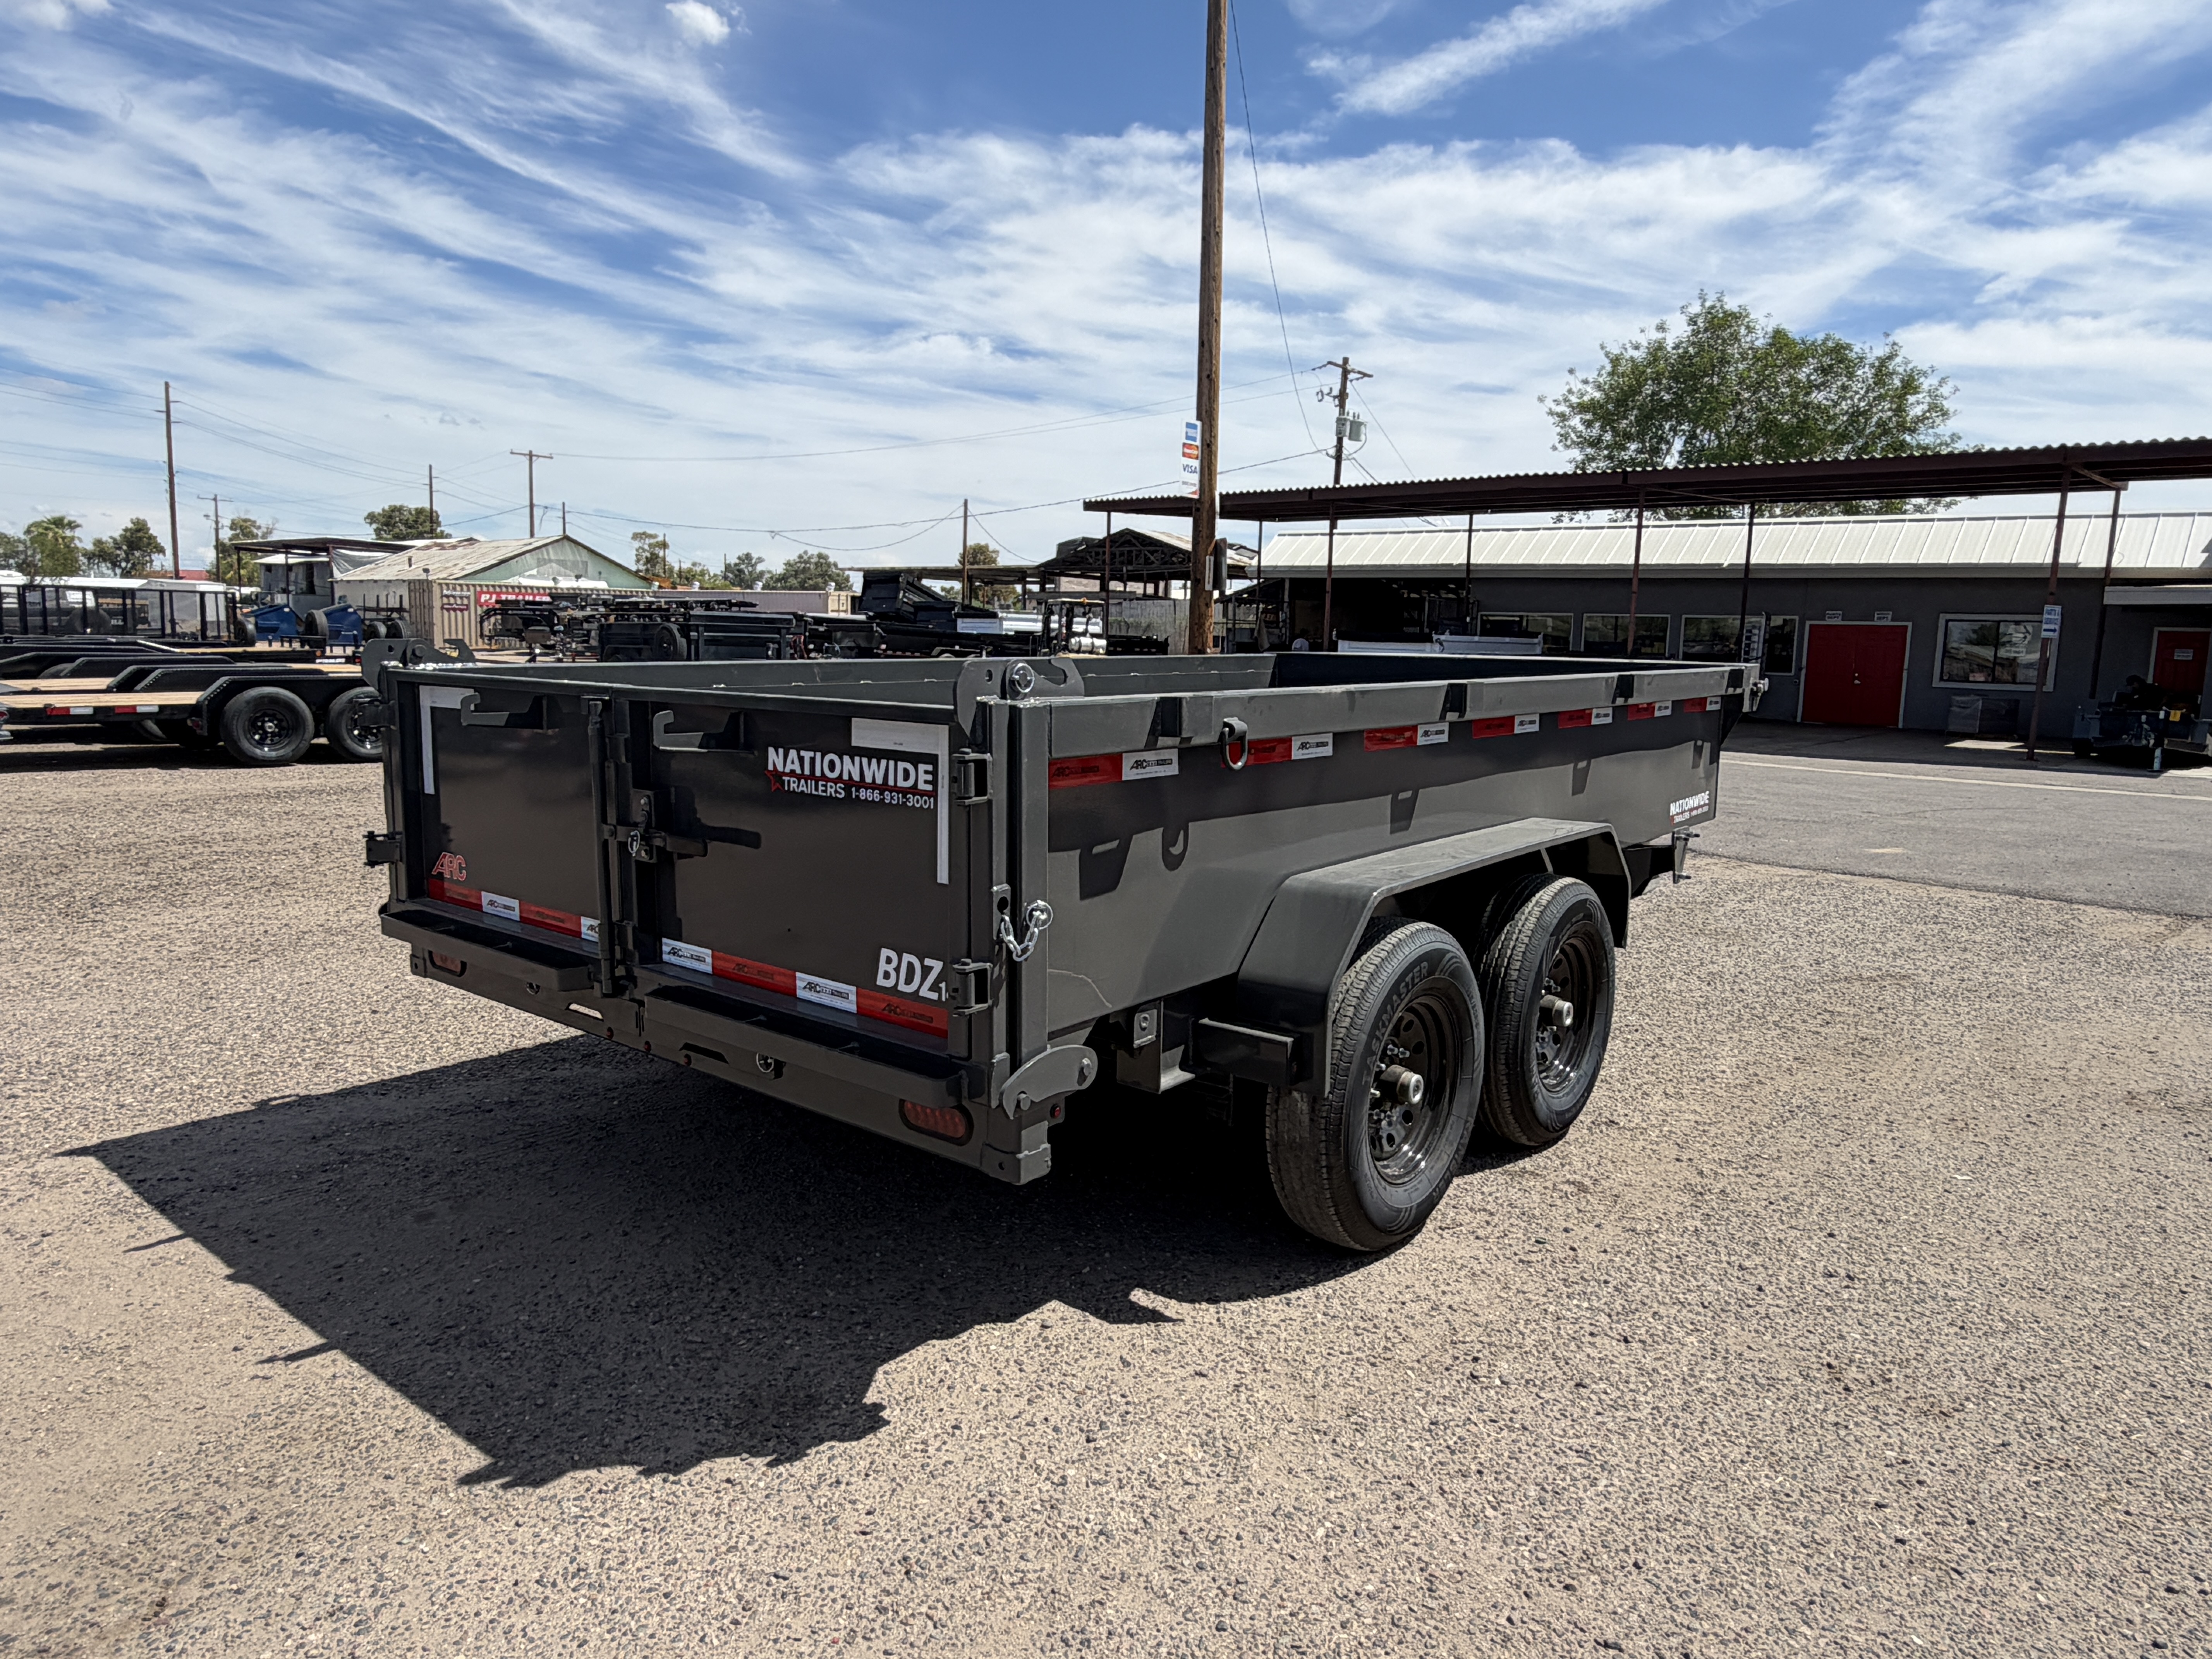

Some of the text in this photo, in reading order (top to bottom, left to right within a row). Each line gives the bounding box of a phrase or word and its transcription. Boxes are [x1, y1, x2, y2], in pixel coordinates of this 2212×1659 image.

[1182, 464, 1197, 474] VISA
[481, 594, 496, 603] PJ
[768, 747, 933, 791] NATIONWIDE
[1130, 759, 1147, 771] ARC
[782, 776, 934, 809] TRAILERS 1-866-931-3001
[1670, 791, 1709, 816] NATIONWIDE
[431, 852, 466, 881] ARC
[802, 981, 821, 994] ARC
[876, 947, 949, 1002] BDZ1
[1362, 962, 1428, 1086] TASKMASTER
